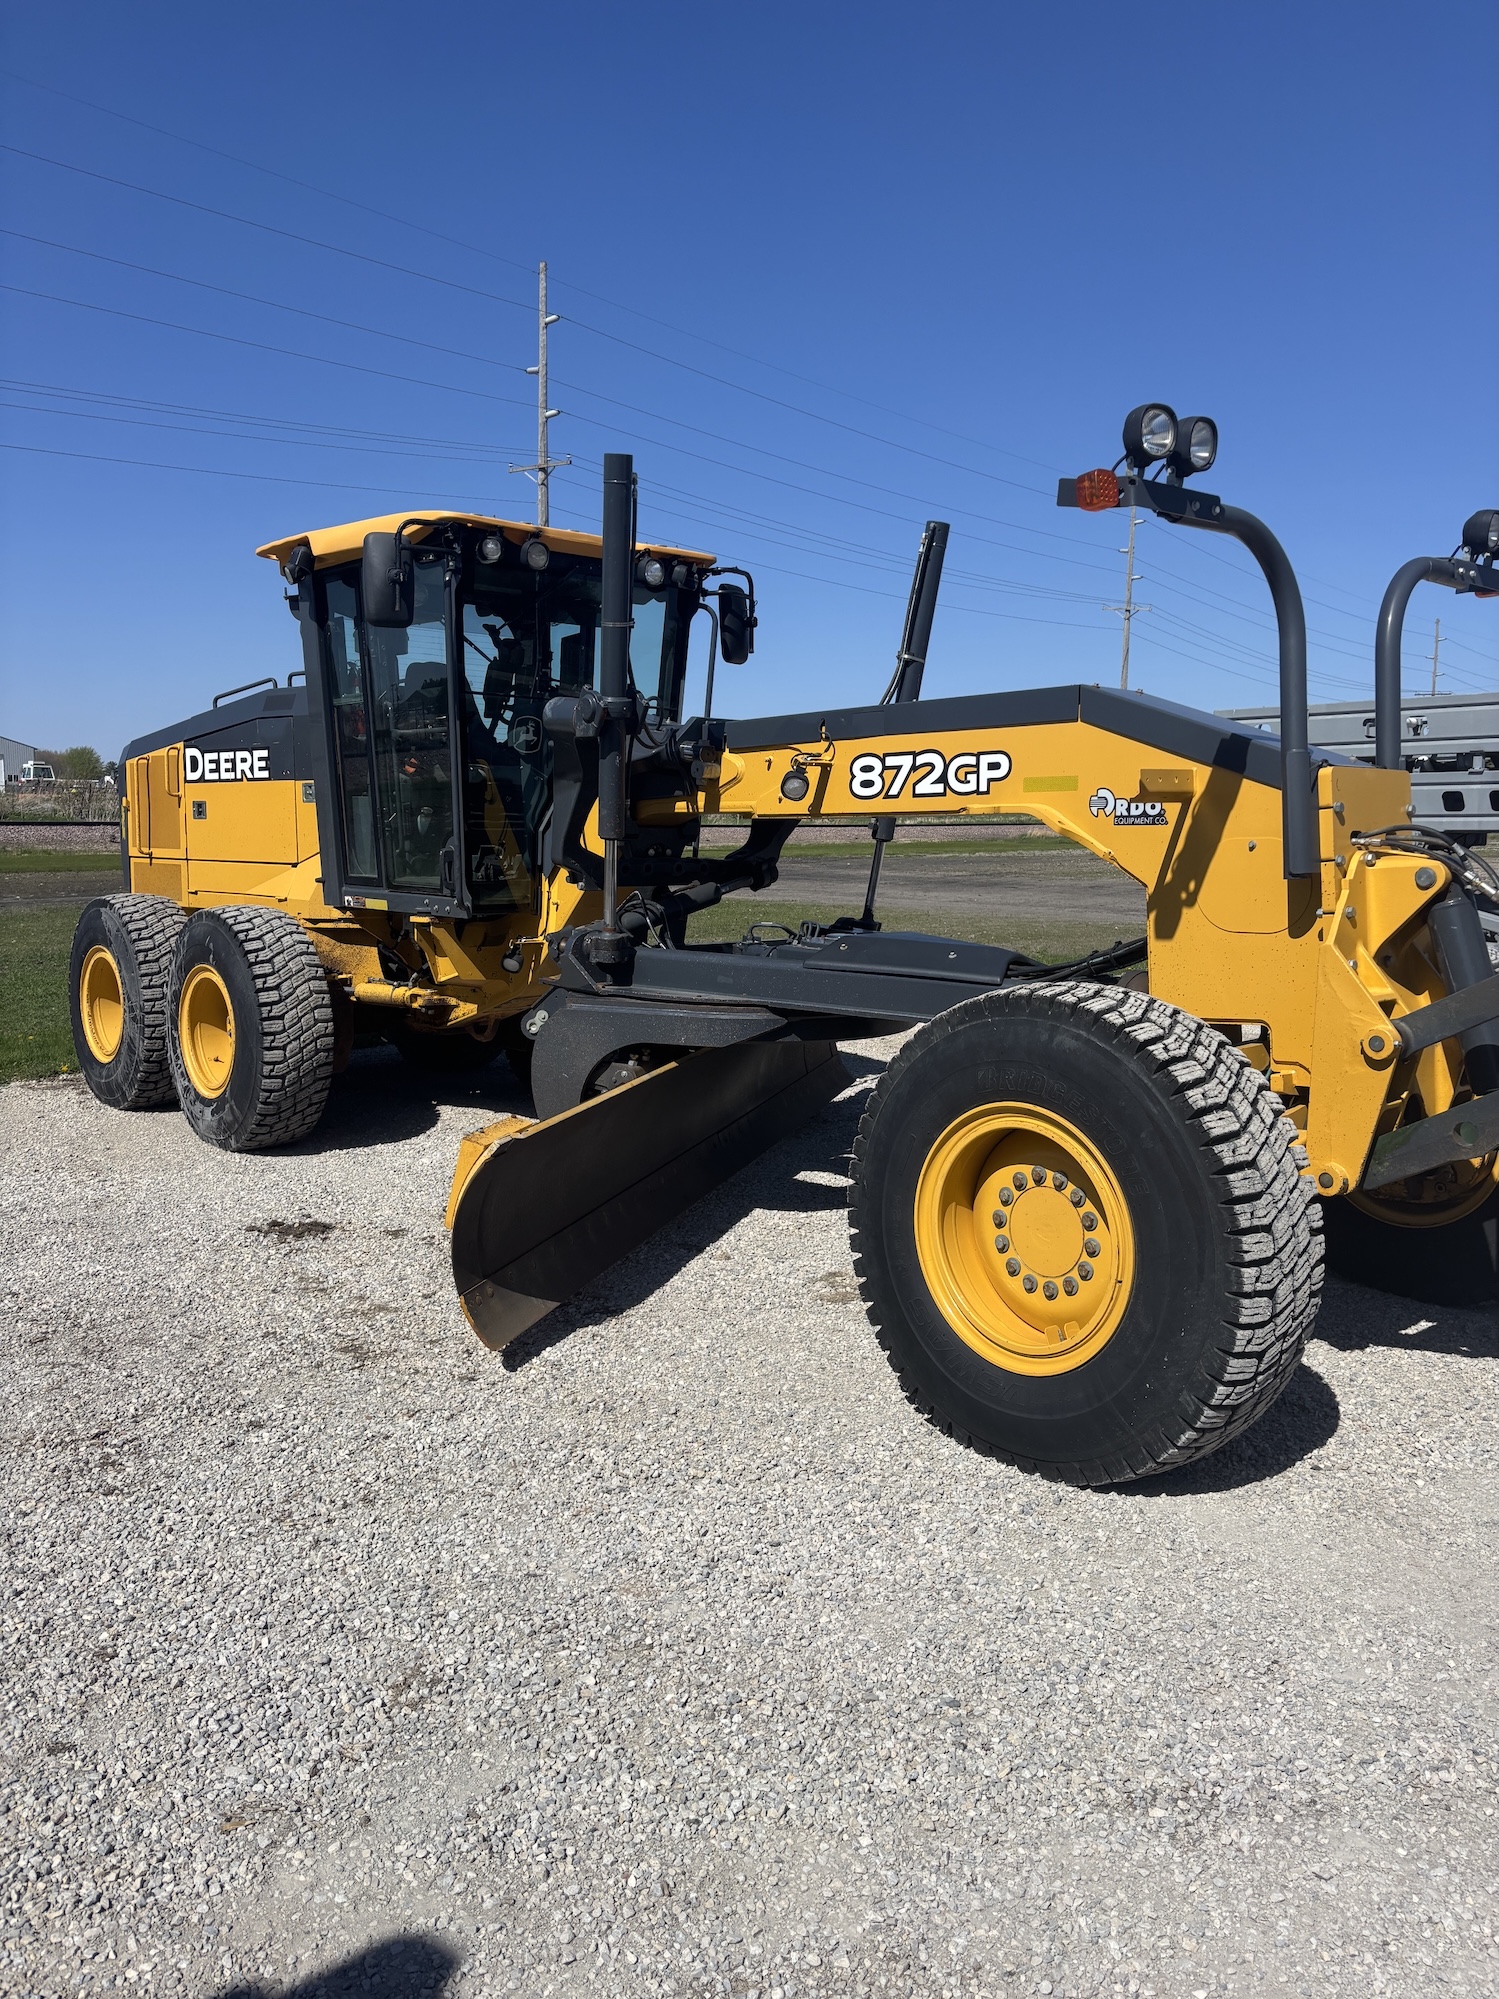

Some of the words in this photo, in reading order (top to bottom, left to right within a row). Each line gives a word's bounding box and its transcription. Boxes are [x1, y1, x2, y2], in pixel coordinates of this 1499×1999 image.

[184, 747, 270, 781] DEERE
[850, 750, 1011, 799] 872GP
[1114, 817, 1153, 825] EQUIPMENT
[1154, 816, 1168, 825] CO.
[976, 1066, 1150, 1196] BRIDGESTONE
